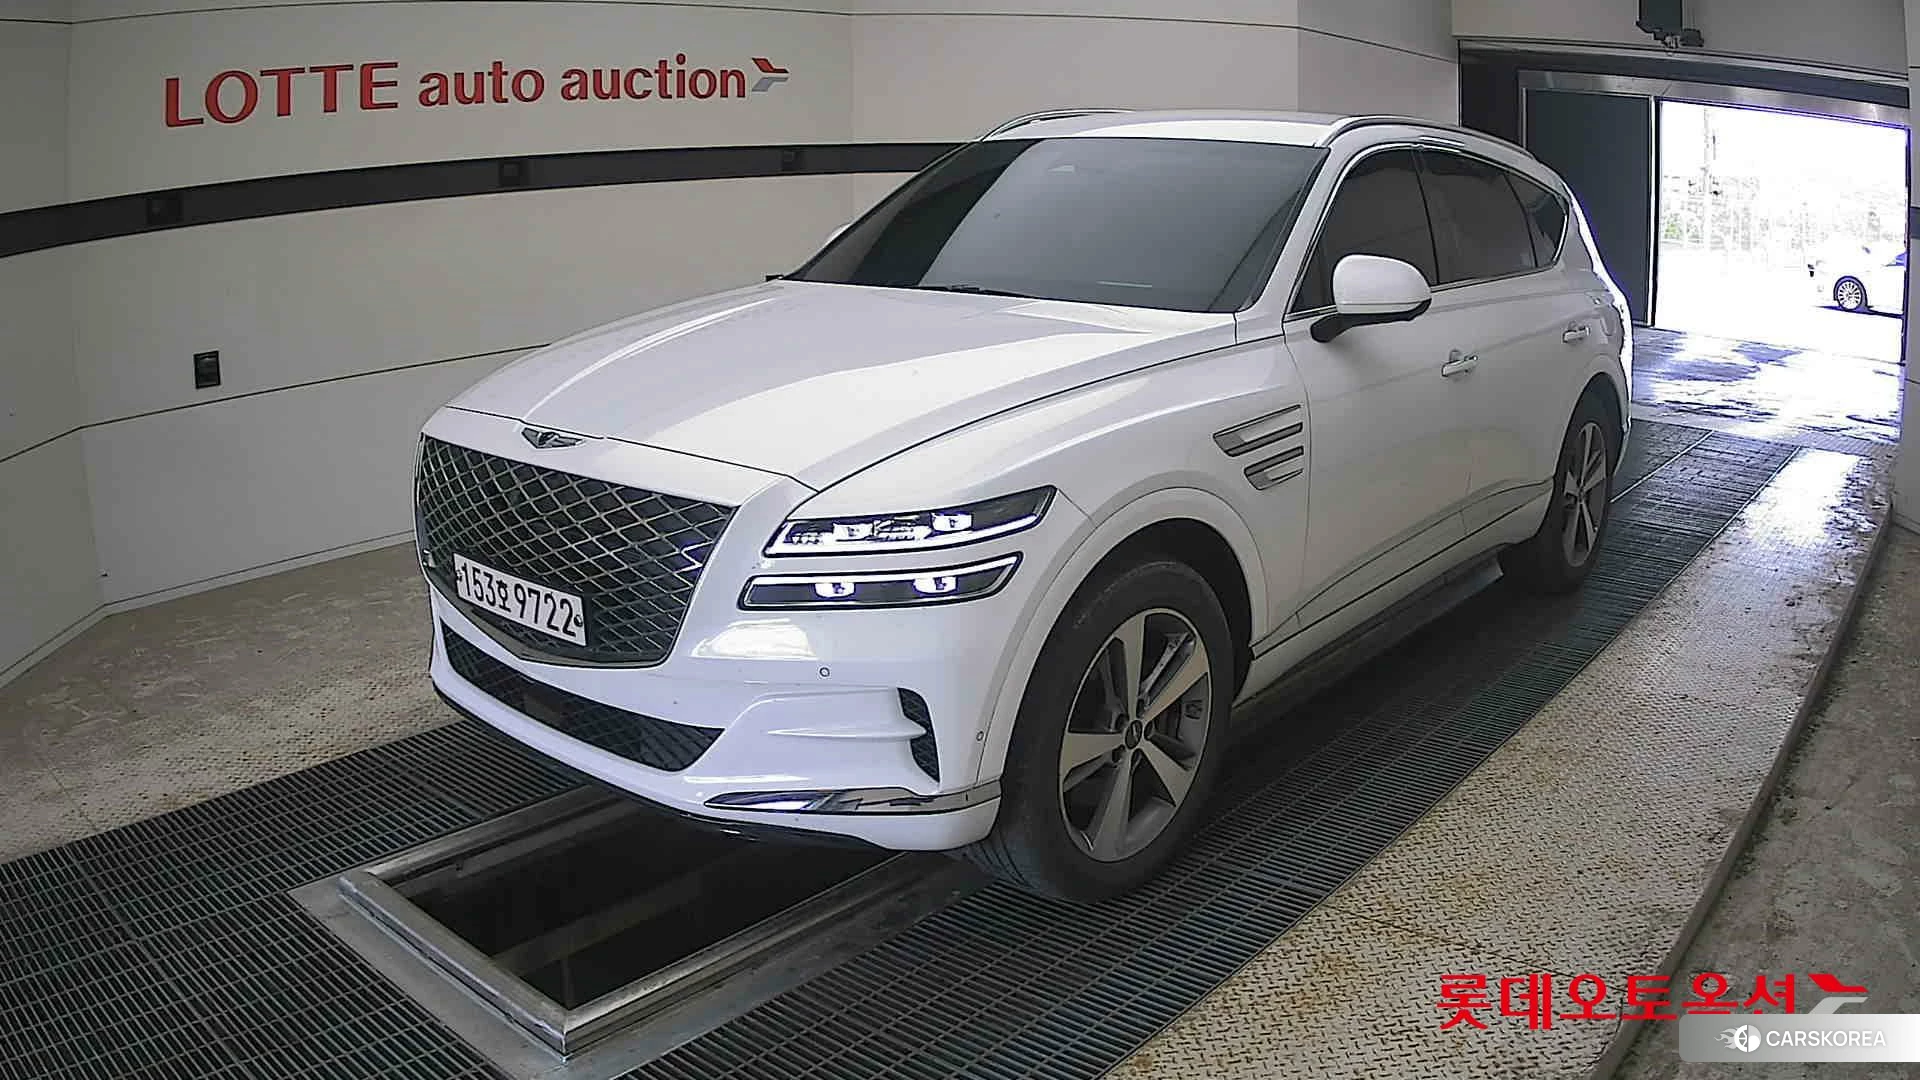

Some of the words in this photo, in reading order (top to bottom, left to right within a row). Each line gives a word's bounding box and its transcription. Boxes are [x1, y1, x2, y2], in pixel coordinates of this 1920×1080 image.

[165, 62, 399, 127] LOTTE
[418, 61, 545, 106] auto
[561, 54, 747, 101] auction
